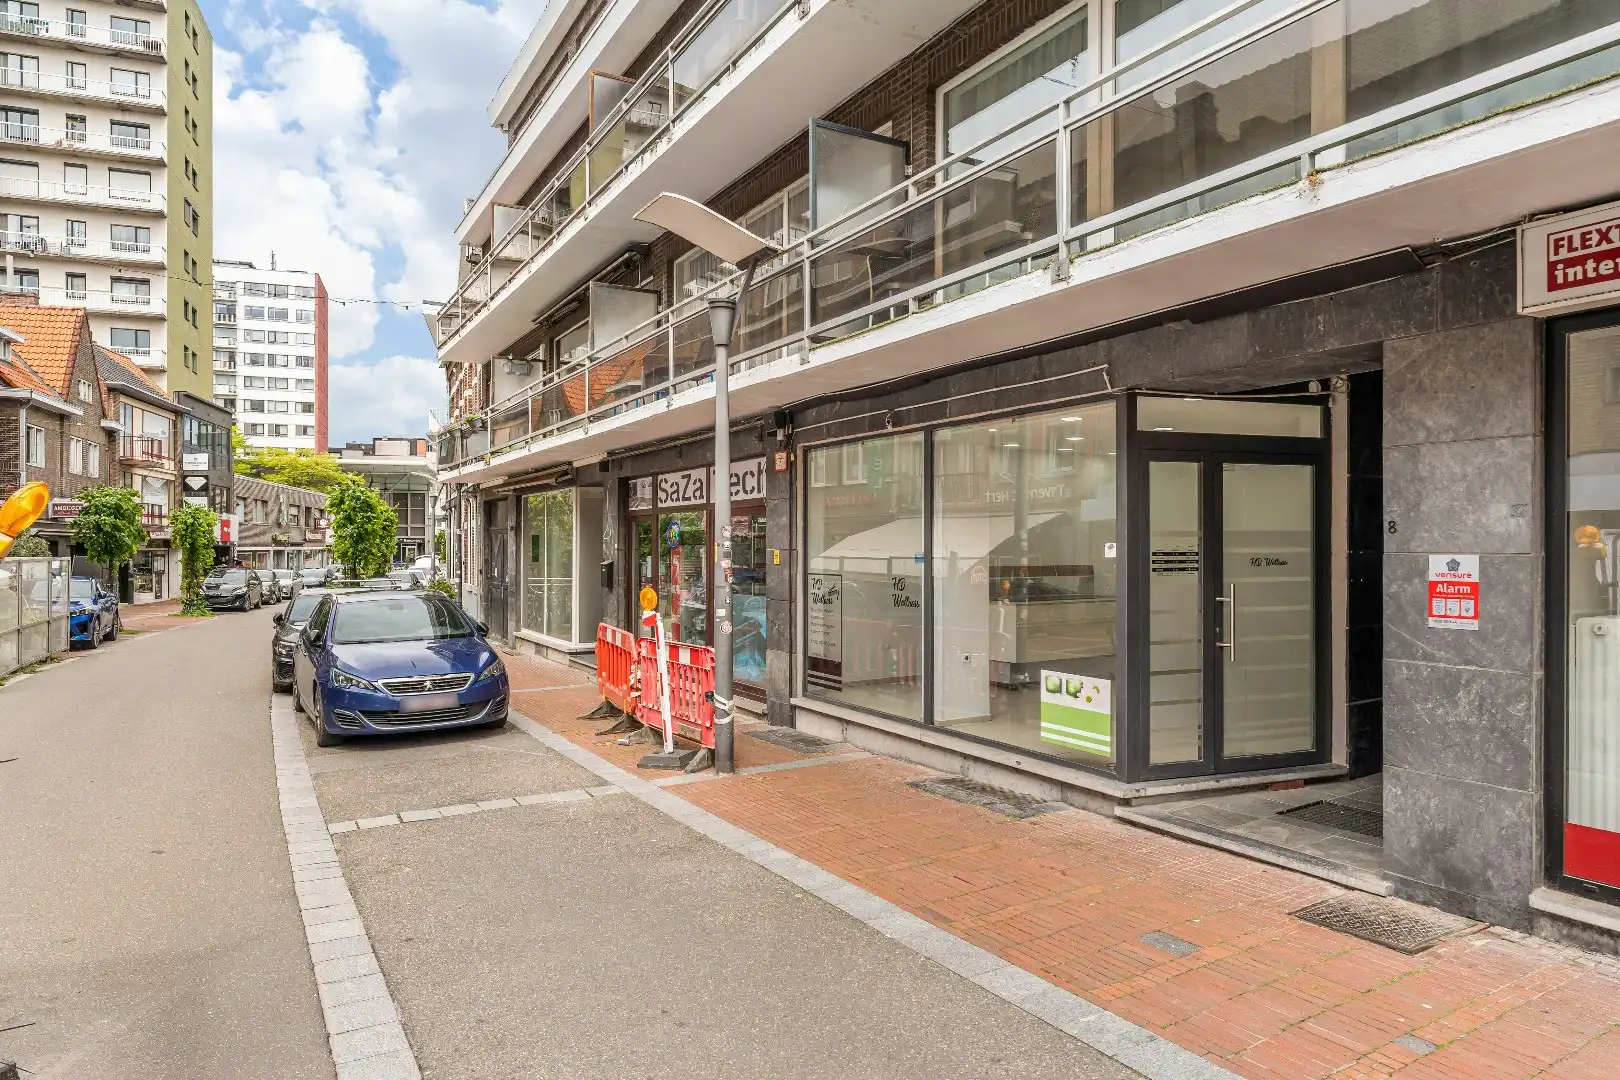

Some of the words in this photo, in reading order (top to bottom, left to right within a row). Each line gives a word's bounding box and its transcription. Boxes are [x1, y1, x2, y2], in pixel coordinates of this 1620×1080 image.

[659, 473, 704, 504] SaZa
[713, 462, 764, 497] ech
[1388, 520, 1397, 534] 8
[1434, 571, 1472, 579] verisure
[1436, 582, 1471, 594] Alarm
[891, 593, 921, 608] Wellness
